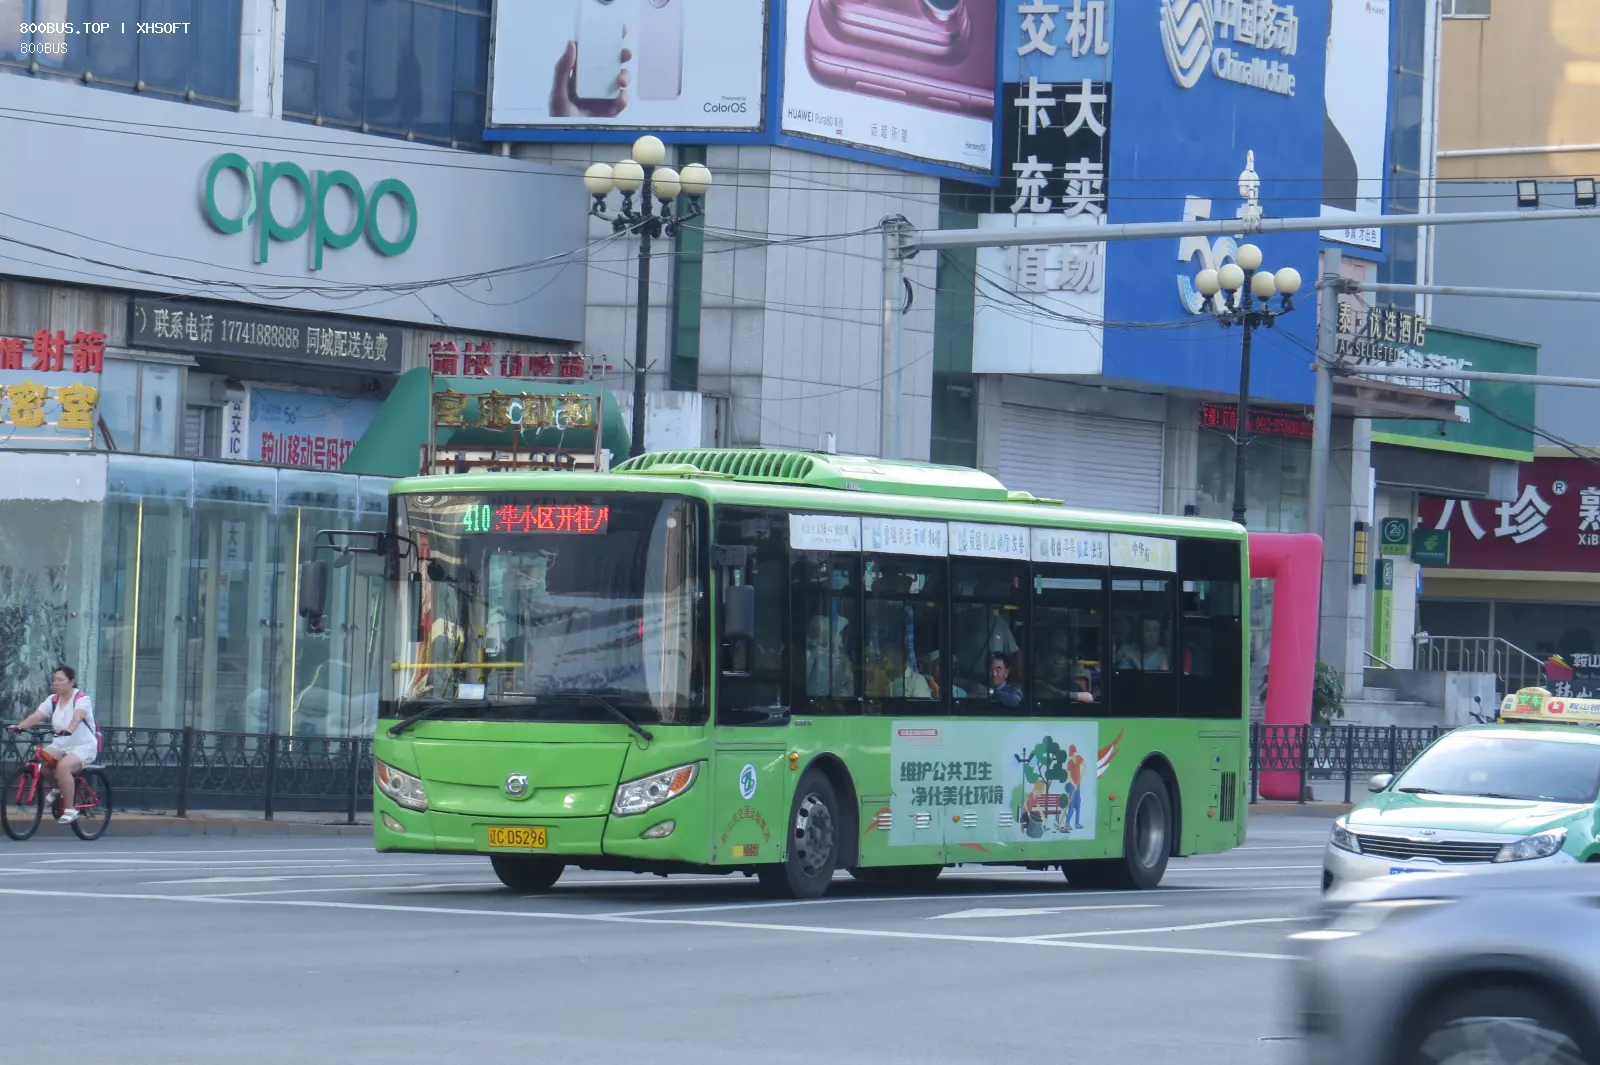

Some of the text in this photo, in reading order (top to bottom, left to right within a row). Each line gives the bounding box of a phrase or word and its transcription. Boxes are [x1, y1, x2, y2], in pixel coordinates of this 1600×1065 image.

[703, 102, 747, 113] ColorOS
[788, 107, 814, 123] HUAWEI
[153, 308, 214, 344] 联系电话
[221, 318, 300, 350] 17741888888
[306, 326, 388, 362] 同城配送免费
[0, 381, 98, 429] 密室
[260, 431, 359, 471] 鞍山移动号码打
[463, 504, 492, 532] 410
[900, 761, 993, 782] 维护公共卫生
[911, 785, 1004, 807] 净化美化环境
